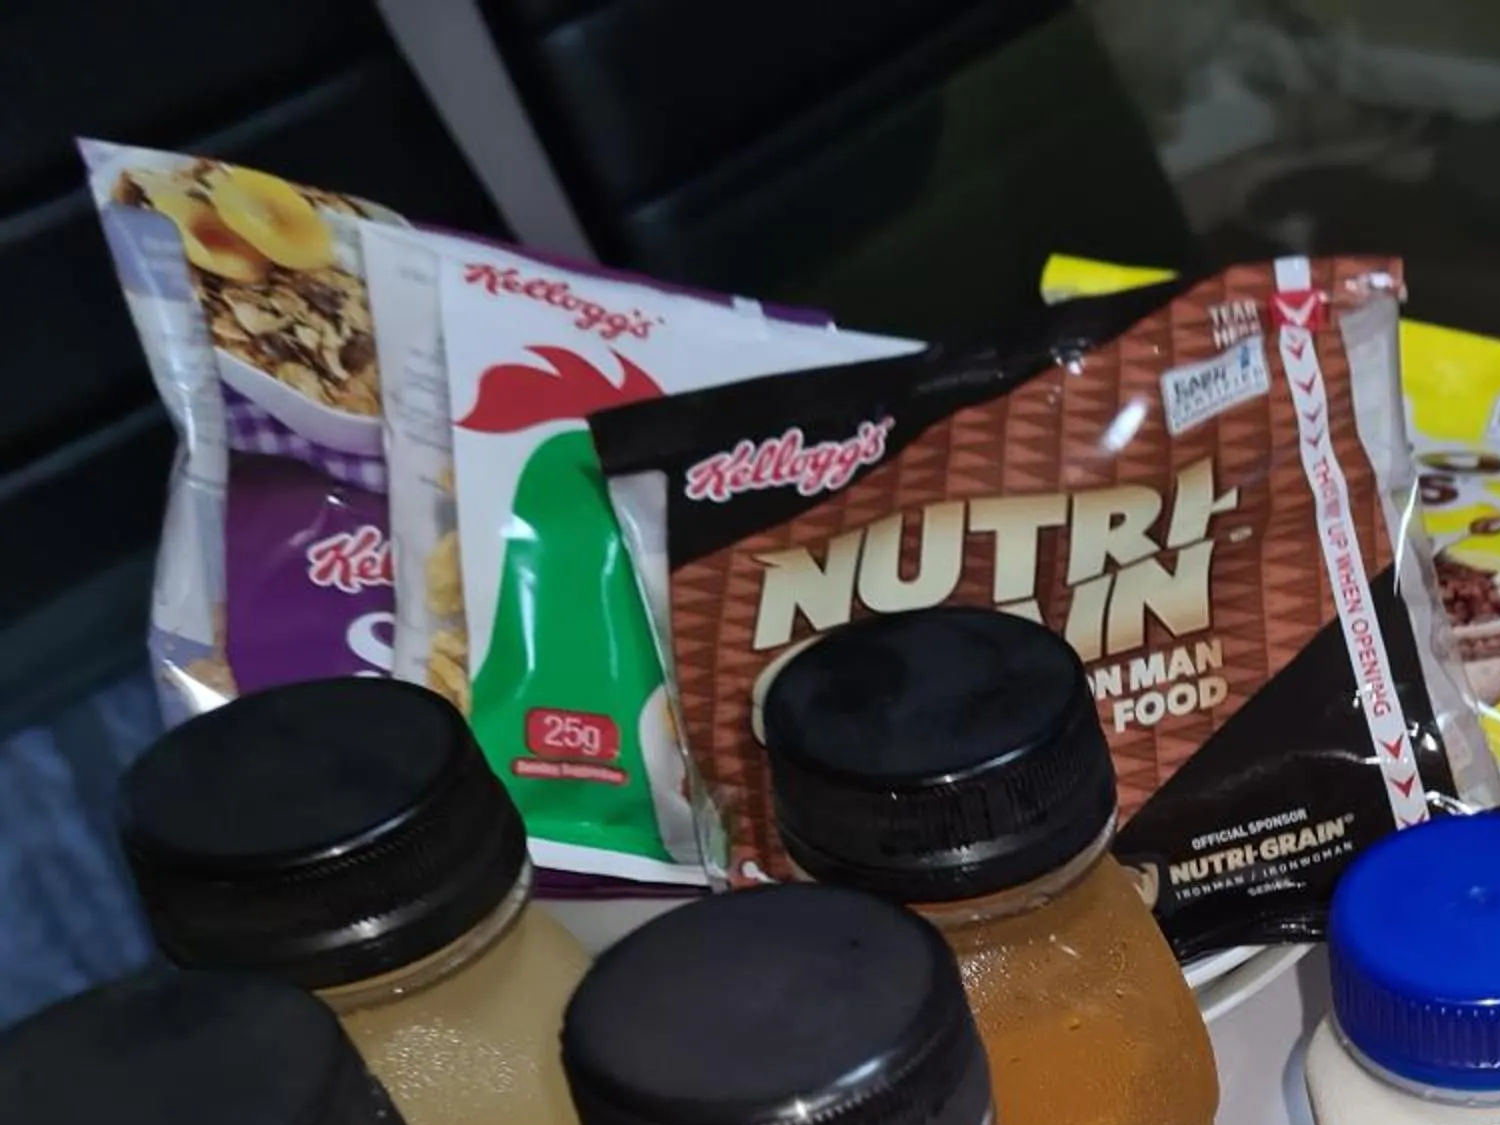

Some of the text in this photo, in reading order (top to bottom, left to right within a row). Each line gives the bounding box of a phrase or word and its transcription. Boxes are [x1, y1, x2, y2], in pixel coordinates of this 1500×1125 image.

[464, 262, 653, 340] Kellogg's
[685, 419, 886, 503] Kellogg's
[1130, 639, 1223, 692] MAN
[1335, 555, 1364, 615] WHEN
[1350, 618, 1393, 718] OPENING
[1113, 676, 1228, 733] FOOD
[543, 714, 601, 756] 25g
[1191, 807, 1308, 851] OFFICIAL SPONSOR
[1175, 874, 1245, 900] IRONMAN
[1263, 841, 1353, 878] IRONWOMAN
